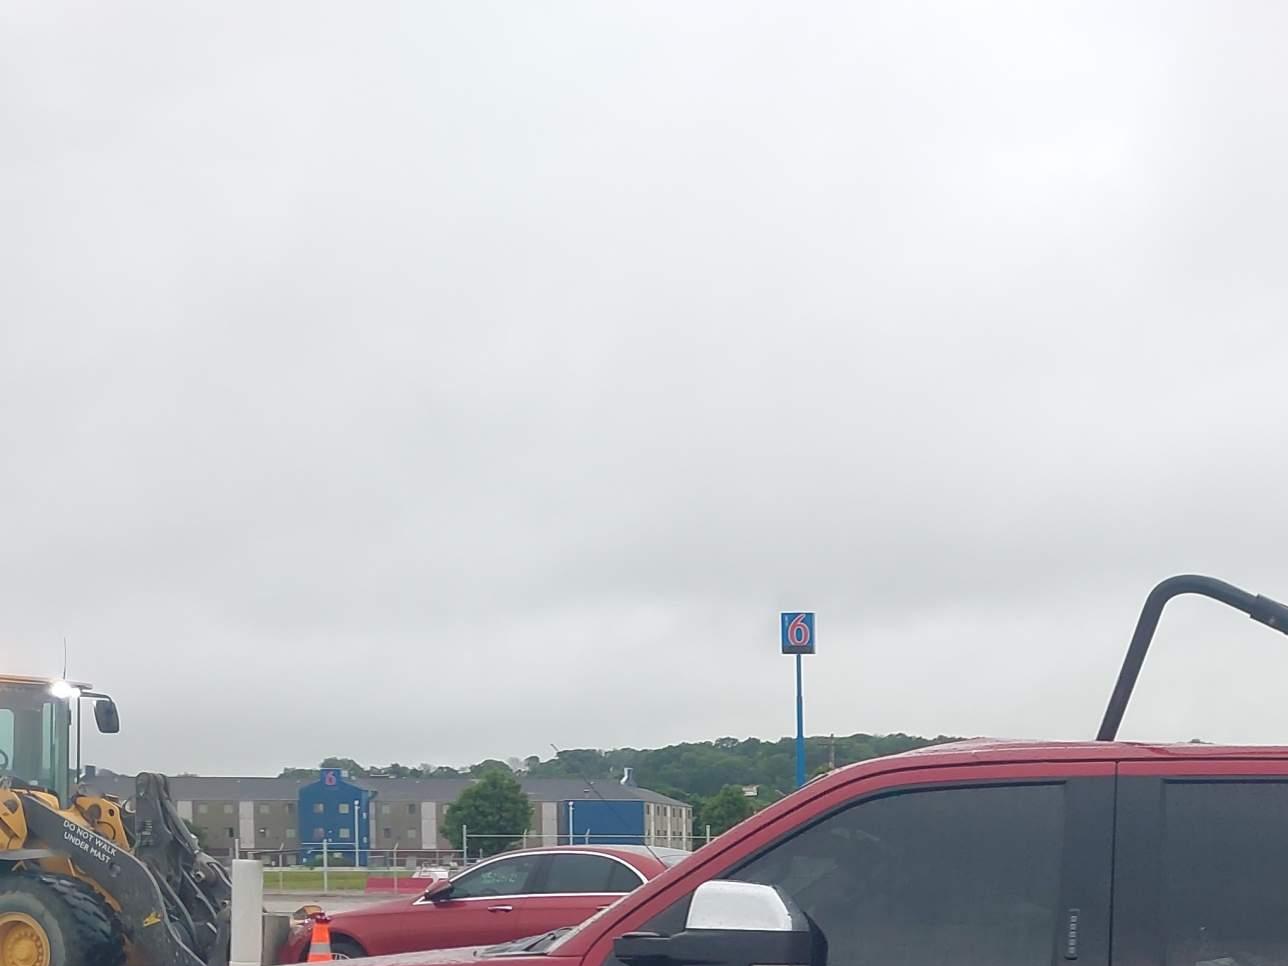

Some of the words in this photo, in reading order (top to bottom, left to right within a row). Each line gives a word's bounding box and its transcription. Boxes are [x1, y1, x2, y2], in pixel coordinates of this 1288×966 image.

[788, 613, 810, 647] 6
[63, 820, 76, 831] DO
[76, 827, 94, 842] NOT
[95, 838, 117, 857] WALK
[63, 831, 90, 852] UNDER
[90, 847, 111, 863] MAST
